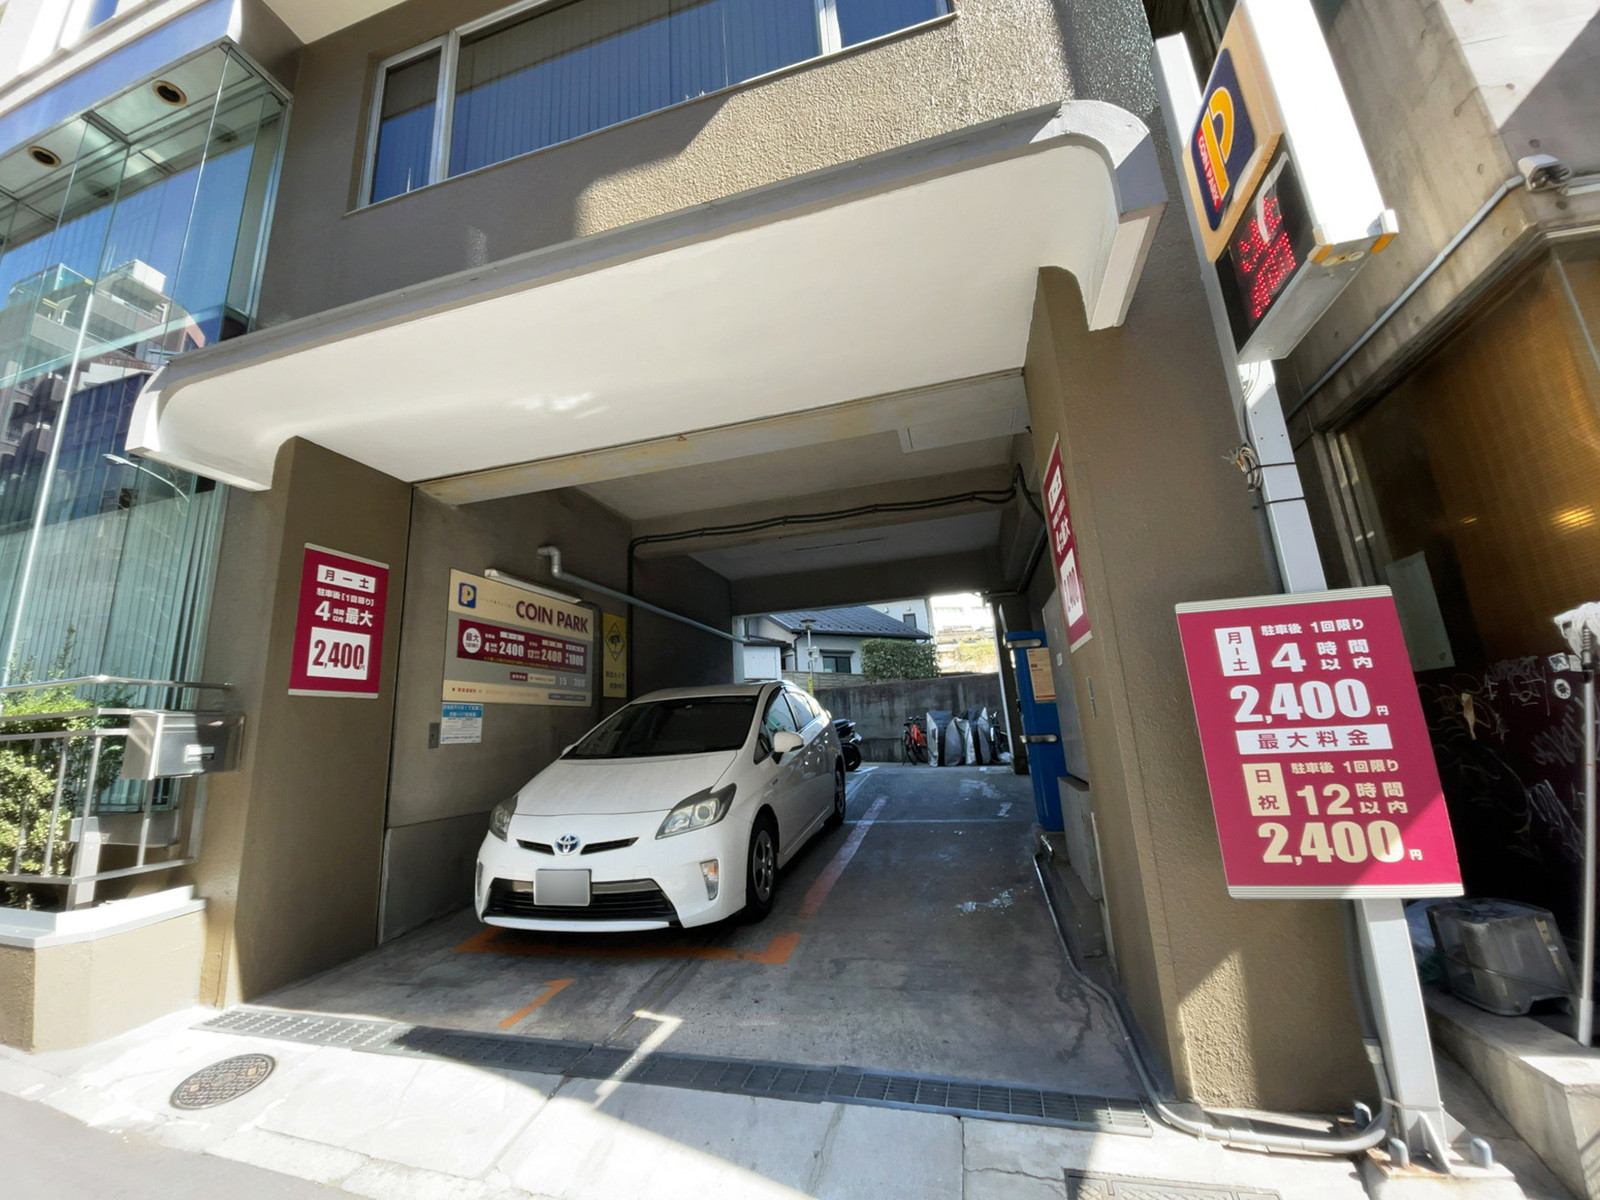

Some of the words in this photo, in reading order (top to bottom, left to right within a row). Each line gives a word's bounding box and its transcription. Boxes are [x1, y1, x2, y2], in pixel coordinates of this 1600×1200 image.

[314, 600, 331, 622] 4
[345, 606, 374, 628] 最大
[516, 600, 554, 626] COIN
[556, 610, 588, 634] PARK
[499, 641, 525, 658] 2400
[541, 648, 563, 663] 2400
[1271, 642, 1306, 672] 4
[1257, 729, 1371, 750] 最大料金
[1296, 783, 1354, 816] 12
